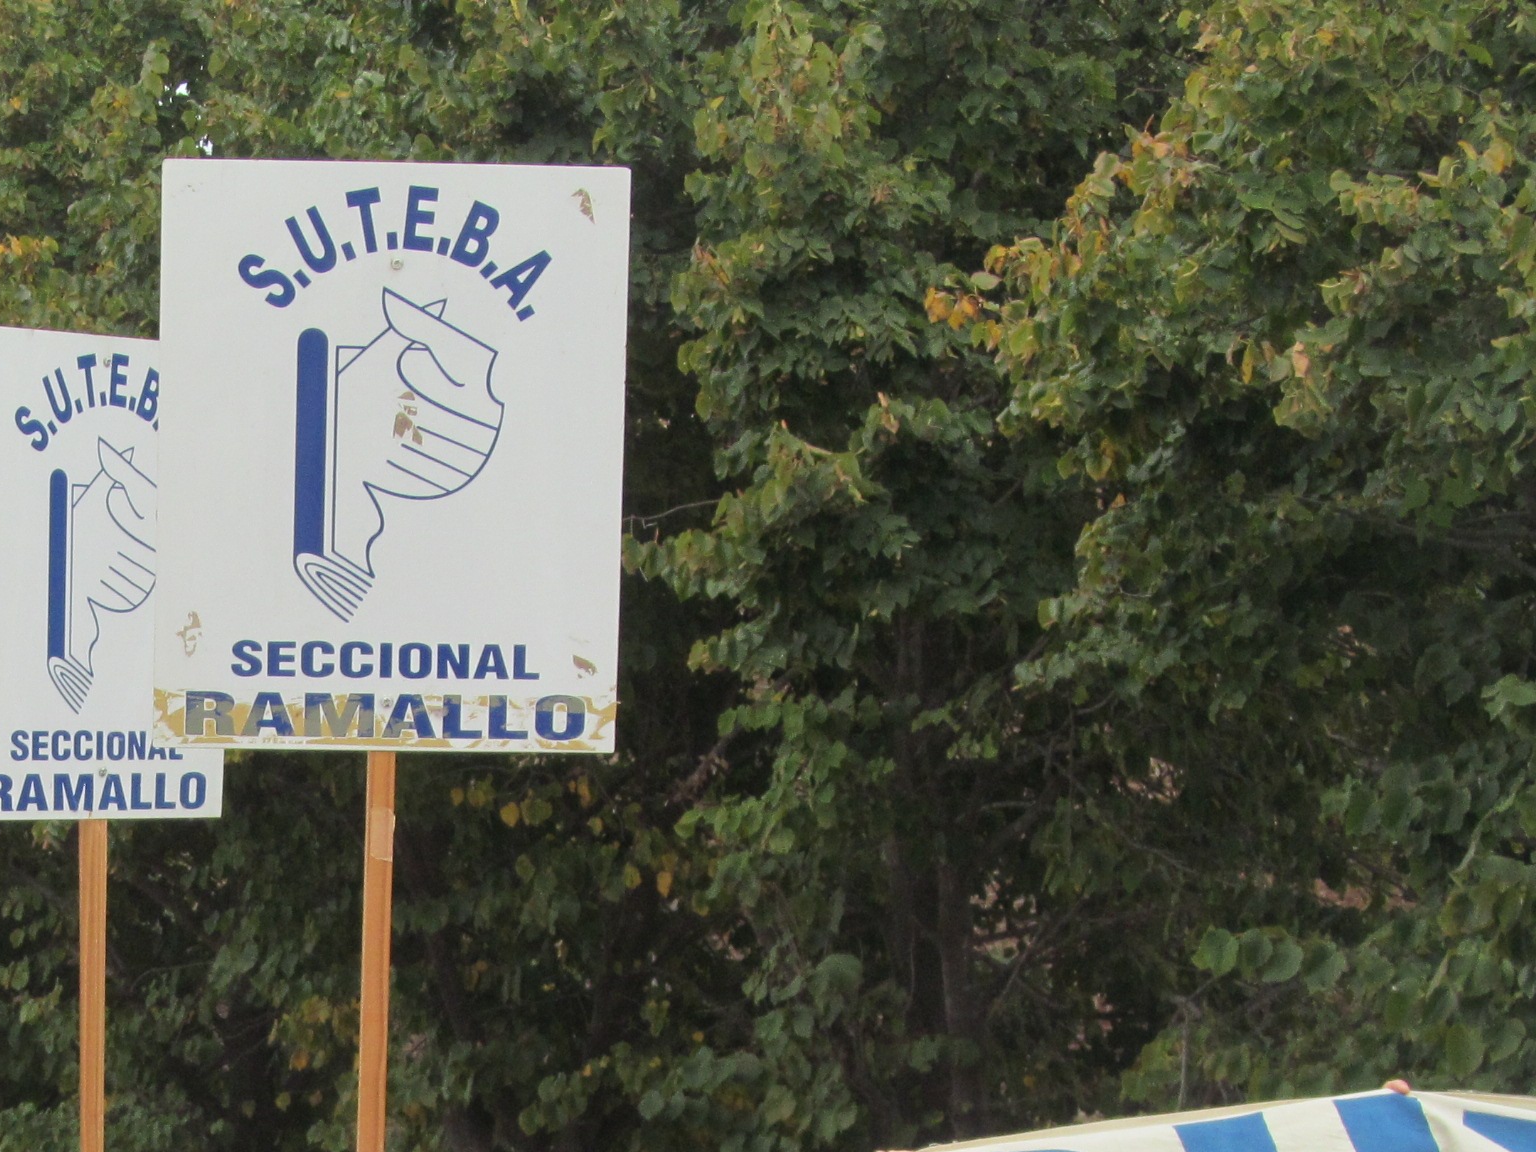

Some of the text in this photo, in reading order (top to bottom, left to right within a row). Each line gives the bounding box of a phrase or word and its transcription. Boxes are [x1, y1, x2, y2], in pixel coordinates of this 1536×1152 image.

[238, 185, 552, 321] S.U.T.E.B.A.
[231, 640, 540, 680] SECCIONAL
[184, 690, 586, 741] RAMALLO
